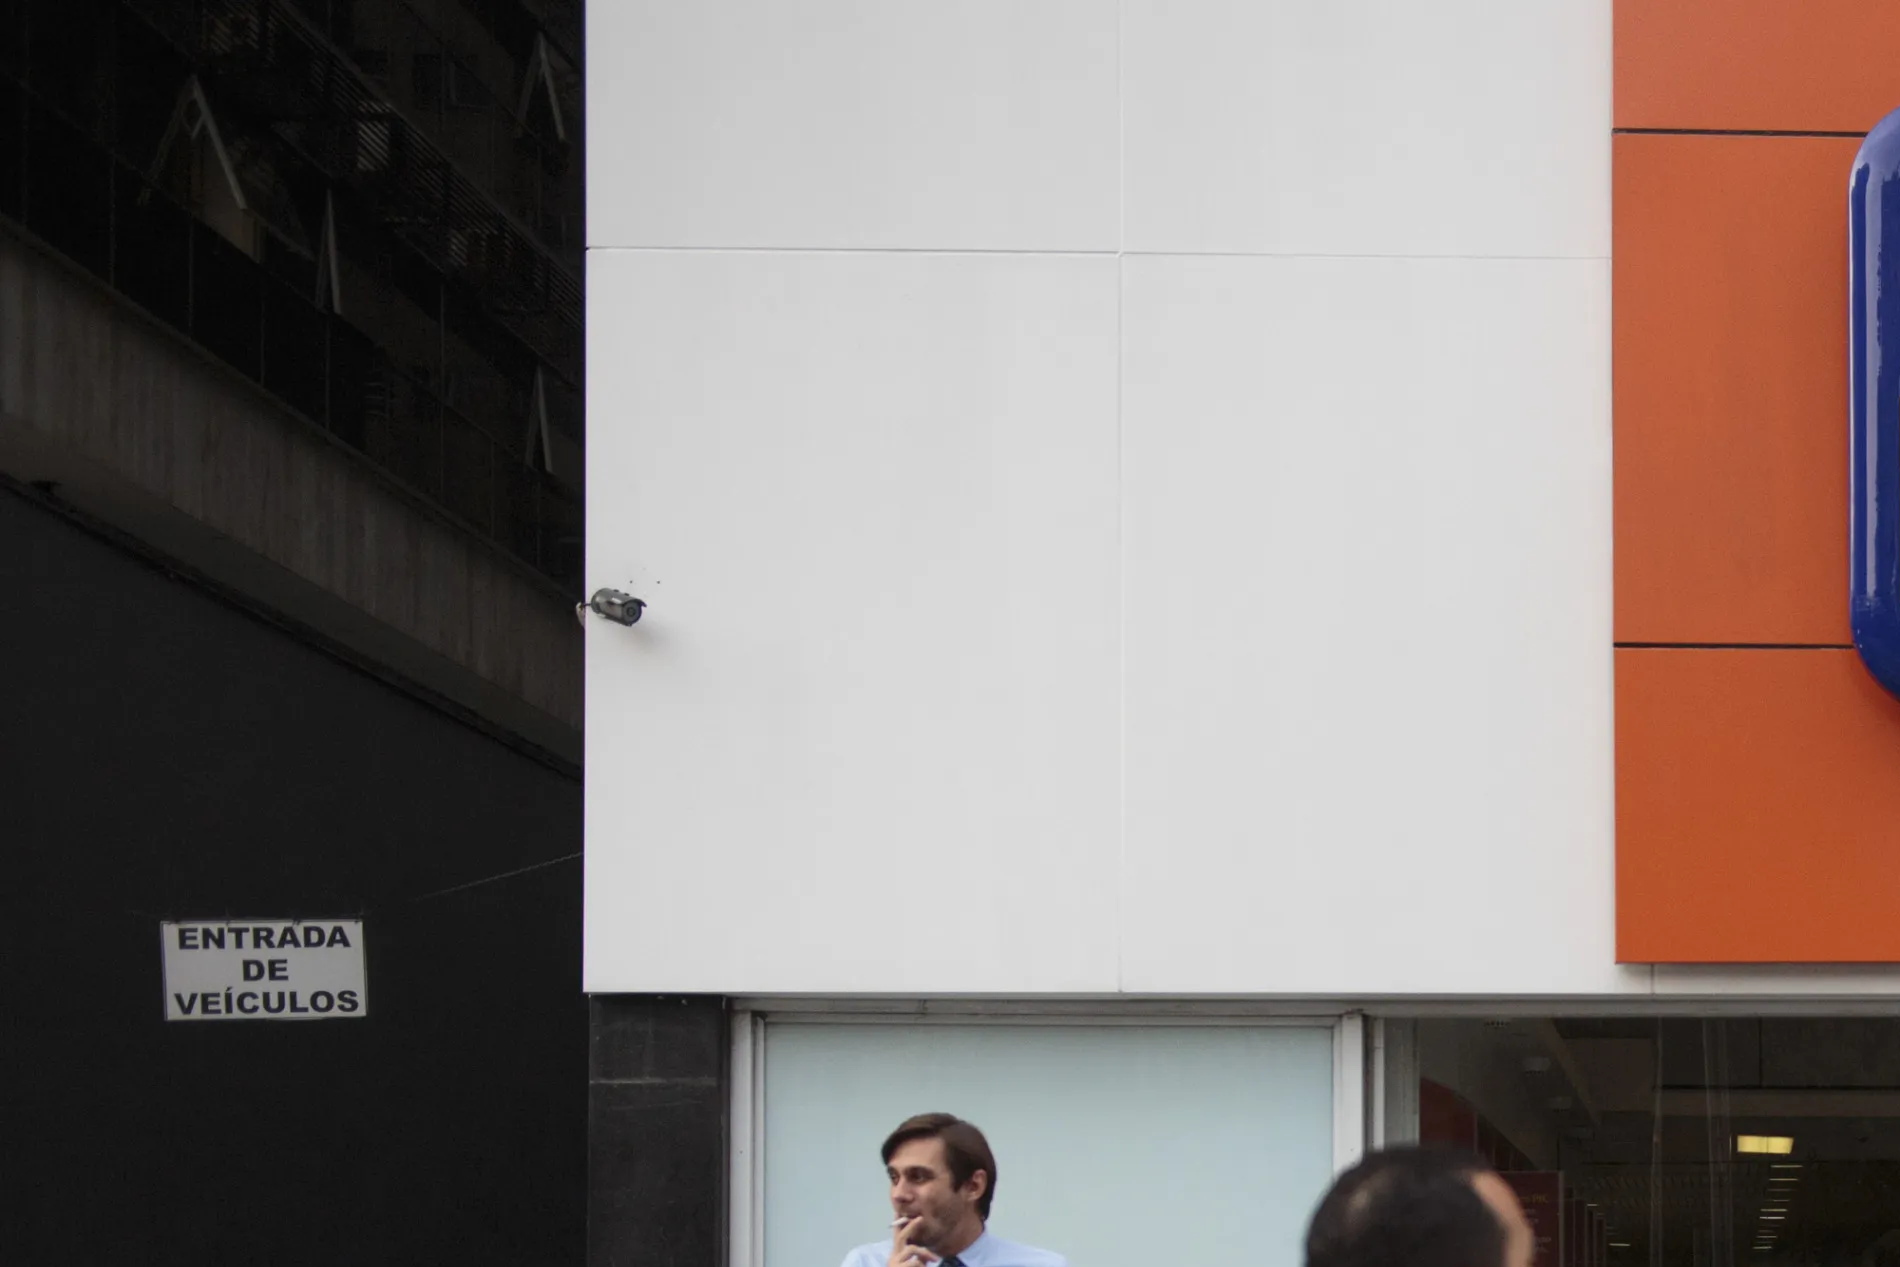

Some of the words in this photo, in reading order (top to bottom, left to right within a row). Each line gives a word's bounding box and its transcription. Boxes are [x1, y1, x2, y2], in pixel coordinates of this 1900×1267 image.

[178, 925, 352, 950] ENTRADA
[242, 958, 290, 982] DE
[174, 986, 359, 1016] VEÍCULOS
